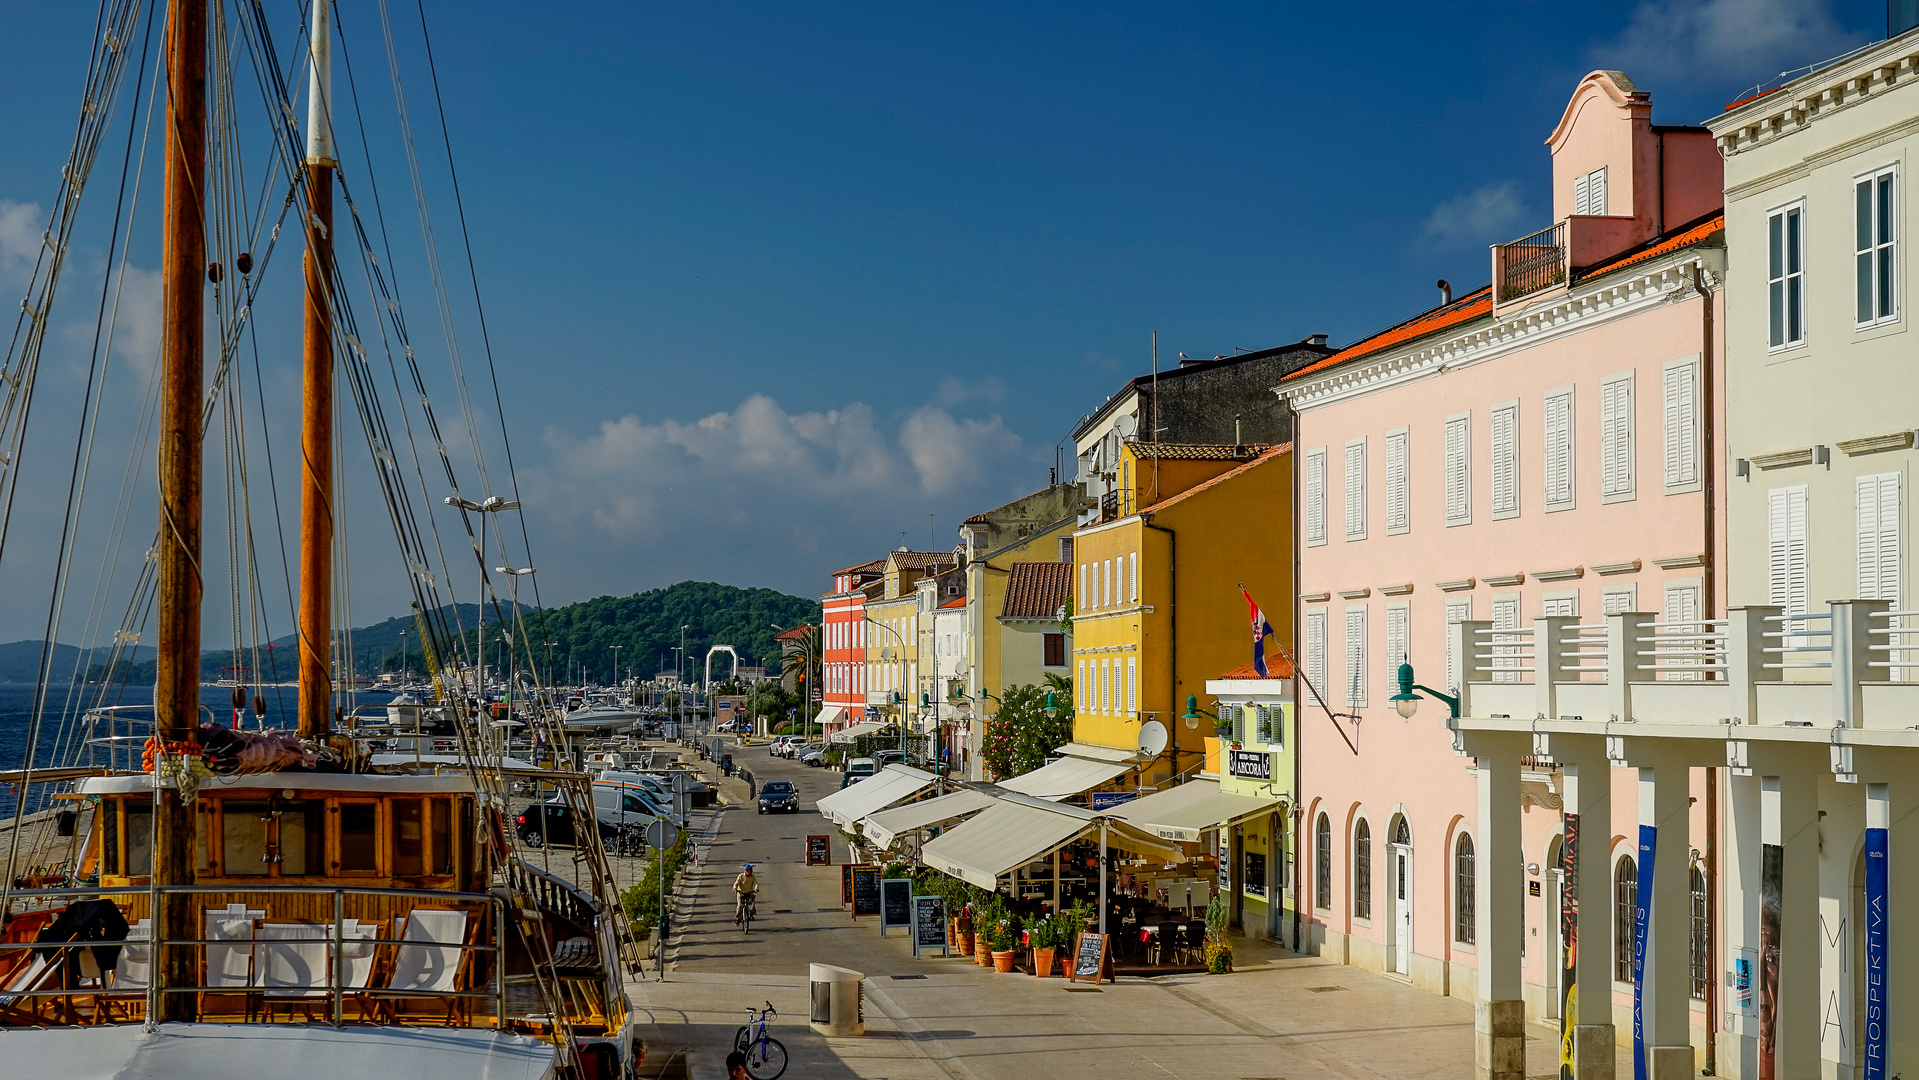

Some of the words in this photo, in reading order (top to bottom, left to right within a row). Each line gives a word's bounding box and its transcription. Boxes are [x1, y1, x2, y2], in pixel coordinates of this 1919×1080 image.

[1236, 761, 1262, 776] ANCORA
[1634, 907, 1646, 972] SOLIS
[1868, 895, 1882, 1080] TROSPEKTIVA
